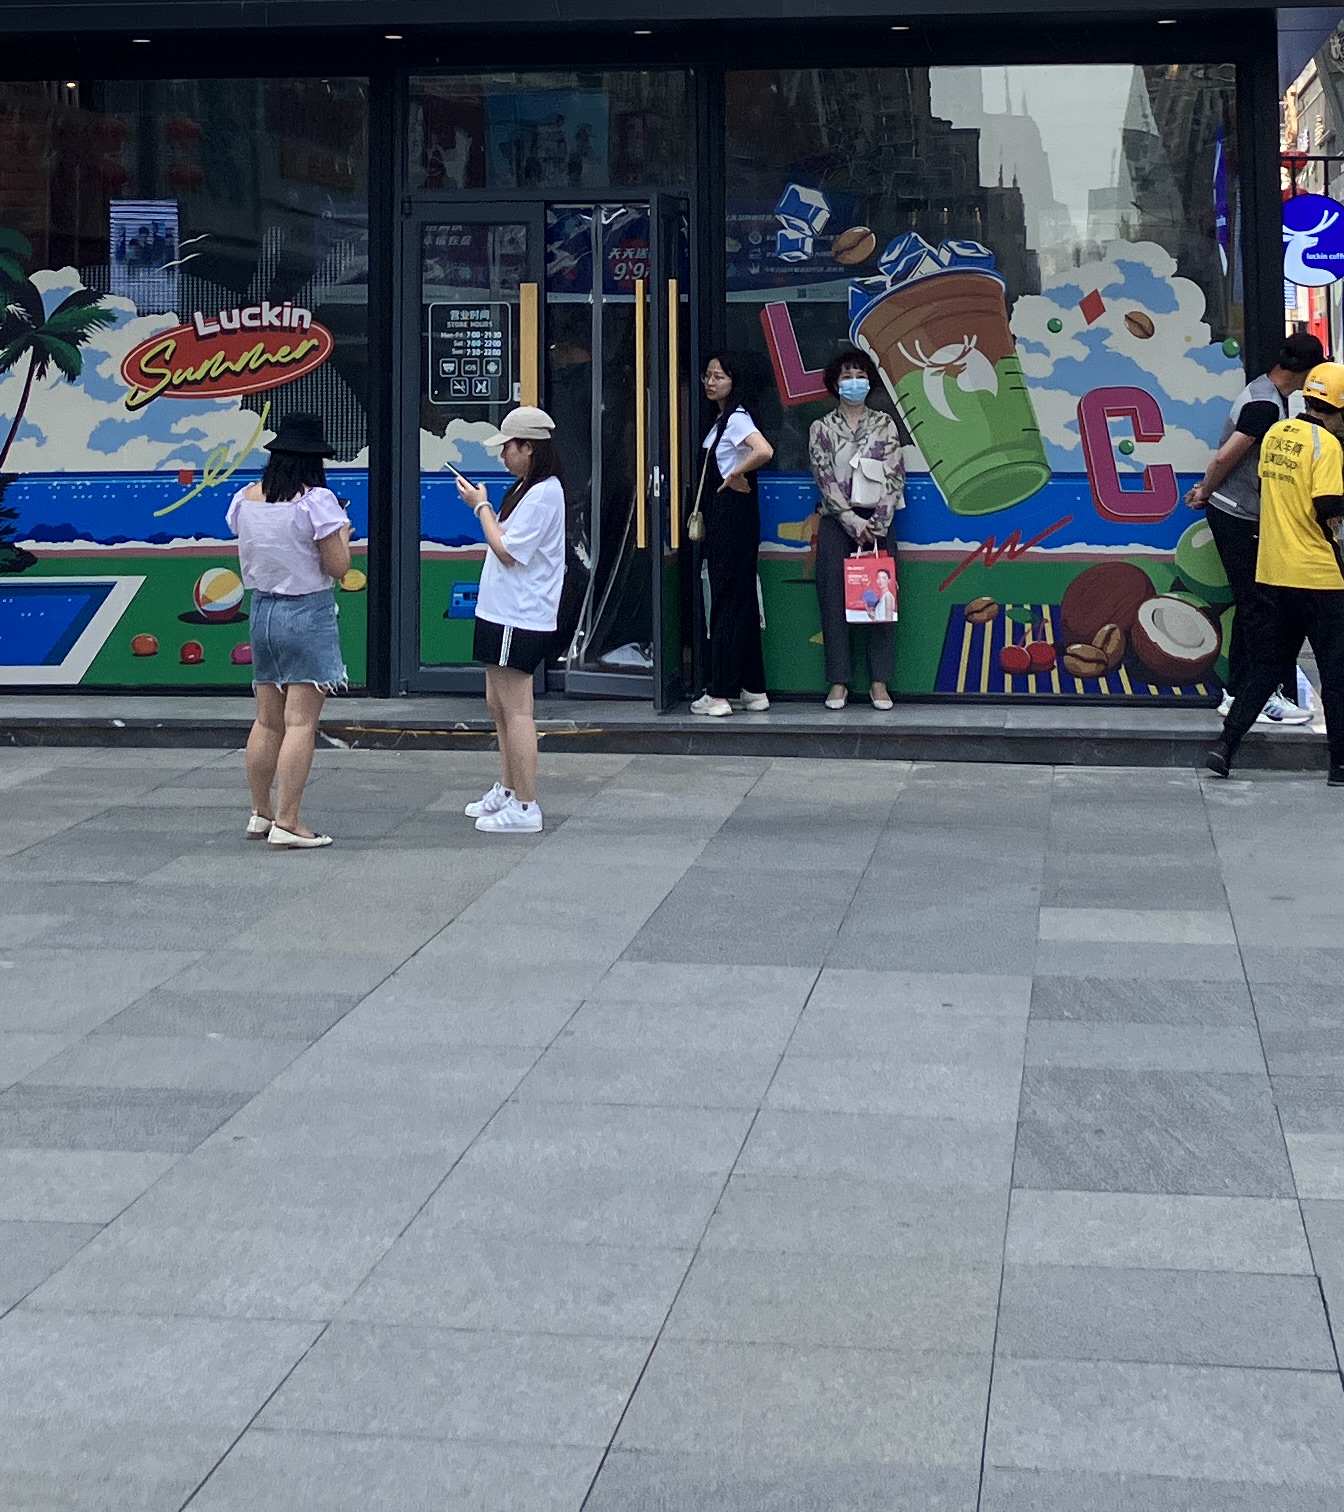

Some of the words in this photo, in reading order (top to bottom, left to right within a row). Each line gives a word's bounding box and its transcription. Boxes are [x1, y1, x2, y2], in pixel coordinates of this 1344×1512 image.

[193, 301, 313, 337] Luckin
[449, 309, 491, 321] 营业时间
[125, 338, 320, 410] Summer
